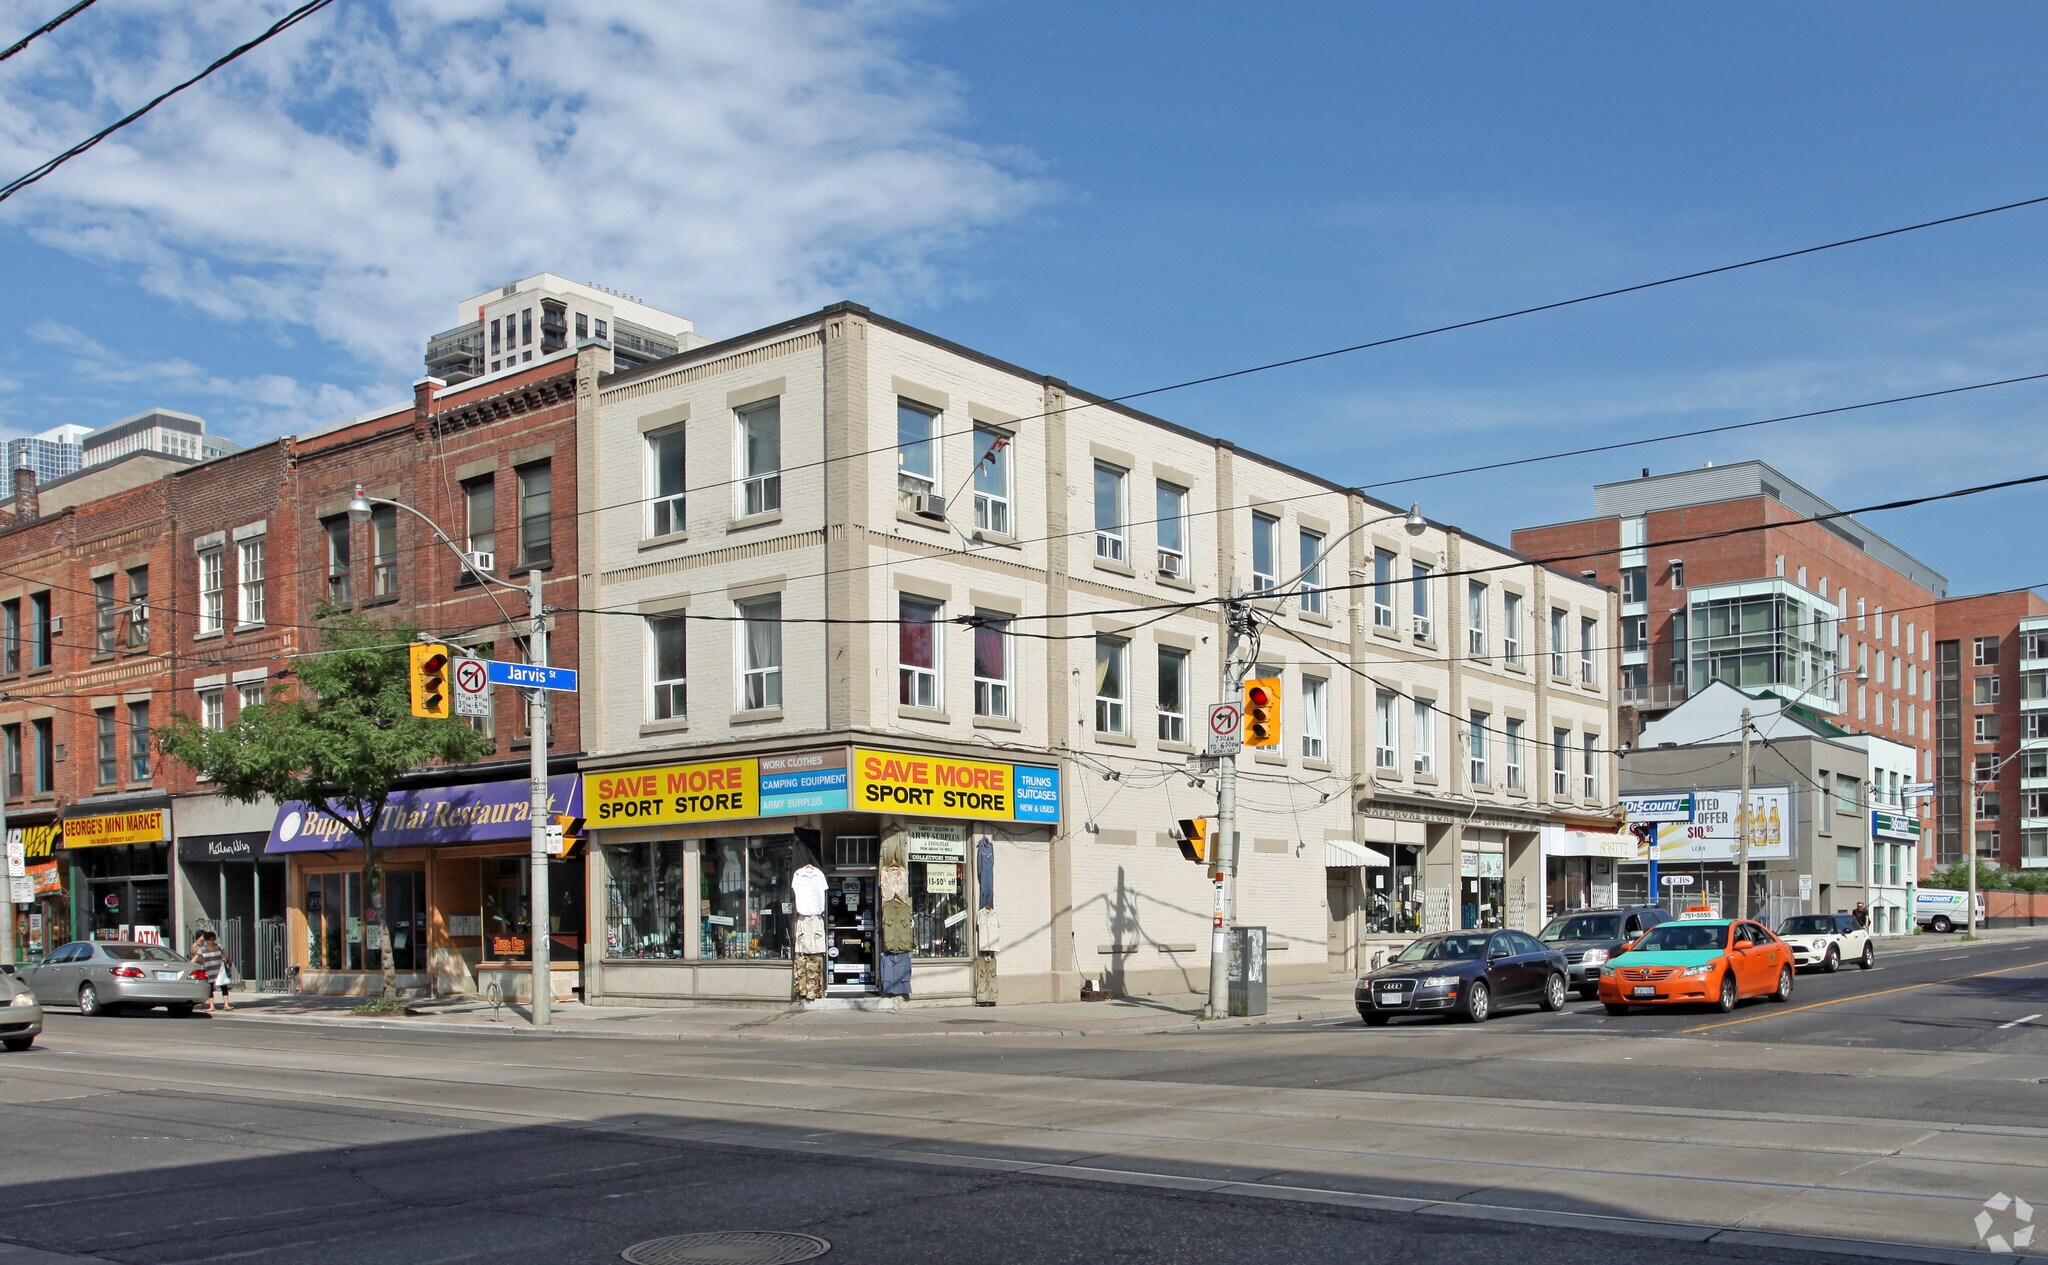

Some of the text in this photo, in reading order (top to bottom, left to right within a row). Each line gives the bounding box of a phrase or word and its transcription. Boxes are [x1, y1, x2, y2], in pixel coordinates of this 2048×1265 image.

[507, 666, 557, 683] Jarvis St
[761, 755, 823, 770] WORK CLOTHES
[761, 773, 847, 791] CAMPING EQUIPMENT
[864, 757, 1005, 791] SAVE MORE
[1020, 775, 1052, 787] TRUNKS
[598, 766, 743, 800] SAVE MORE
[865, 784, 1006, 812] SPORT STORE
[1016, 788, 1057, 801] SUITCASES
[598, 791, 743, 820] SPORT STORE
[761, 796, 823, 811] ARMY SURPLUS
[1019, 803, 1055, 814] NEW & USED
[380, 802, 431, 833] Thai
[430, 793, 556, 828] Restaurat
[1698, 811, 1728, 824] OFFER
[64, 812, 162, 837] GEORGE'S MINI MARKET
[7, 823, 62, 858] BWAY
[911, 831, 960, 841] ARMY SURPLUS
[843, 882, 859, 890] OPEN
[1673, 876, 1690, 884] CBS
[137, 930, 160, 946] ATM
